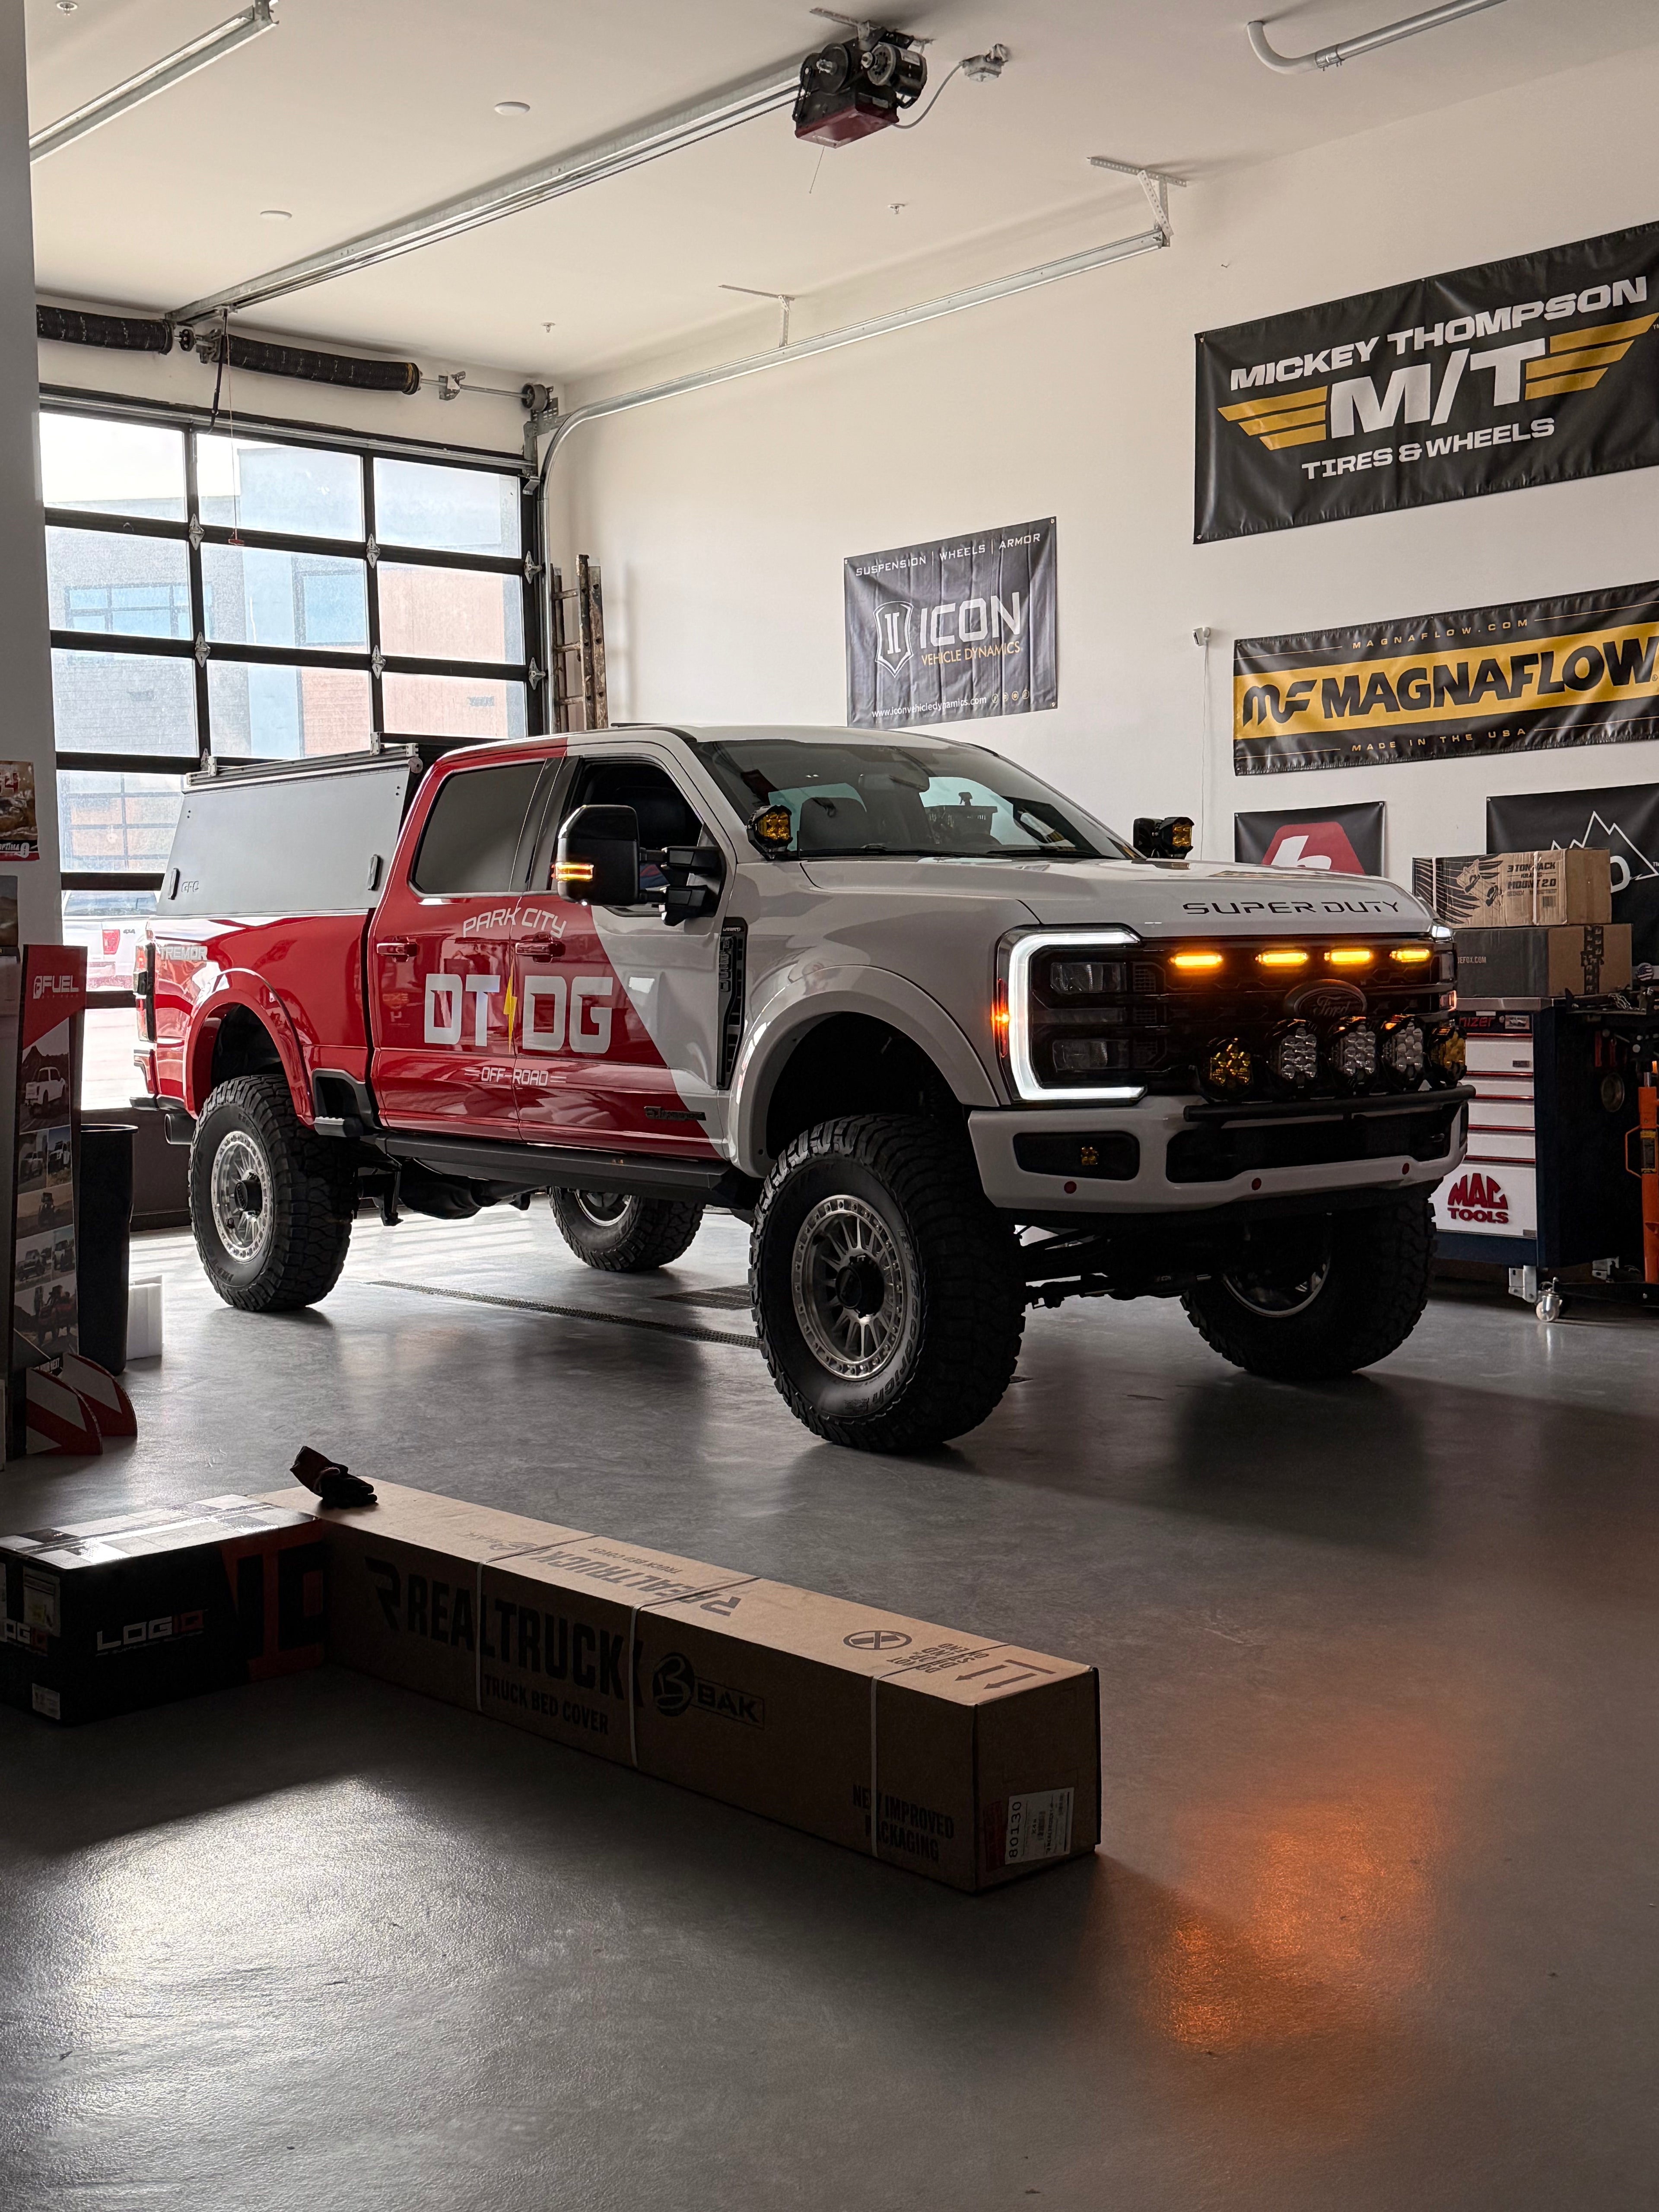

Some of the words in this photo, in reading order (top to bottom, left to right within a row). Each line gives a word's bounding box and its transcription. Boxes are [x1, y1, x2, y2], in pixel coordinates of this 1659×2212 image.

[1230, 337, 1379, 390] MICKEY
[1388, 276, 1647, 355] THOMPSON
[1331, 338, 1545, 439] M/T
[1302, 447, 1393, 480] TIRES
[1399, 442, 1422, 462] &
[1427, 417, 1554, 457] WHEELS
[856, 556, 926, 576] SUSPENSION
[940, 544, 985, 561] WHEELS
[999, 533, 1040, 550] ARMOR
[920, 592, 1020, 648] ICON
[1352, 619, 1529, 649] MAGNAFLOW.COM
[922, 648, 961, 666] VEHICLE
[965, 641, 1020, 660] DYNAMICS
[1321, 636, 1659, 718] MAGNAFLOW
[872, 697, 987, 717] www.iconvehicledynamics.com
[1352, 741, 1396, 751] MADE
[1410, 738, 1425, 746] IN
[1440, 733, 1473, 743] THE
[1489, 728, 1526, 738] USA
[463, 909, 518, 937] PARK
[521, 908, 566, 938] CITY
[1183, 901, 1317, 914] SUPER
[1321, 901, 1398, 913] DUTY
[160, 946, 207, 960] TREMOR
[42, 975, 79, 993] FUEL
[1313, 995, 1351, 1017] Ford
[1448, 1173, 1508, 1209] MAC
[1448, 1208, 1509, 1224] TOOLS
[408, 1573, 626, 1700] REALTRUCK
[485, 1674, 528, 1706] TRUCK
[531, 1689, 559, 1716] BED
[562, 1699, 609, 1735] COVER
[699, 1686, 760, 1723] BAK
[886, 1796, 954, 1839] IMPROVED
[1009, 1802, 1021, 1858] 80130
